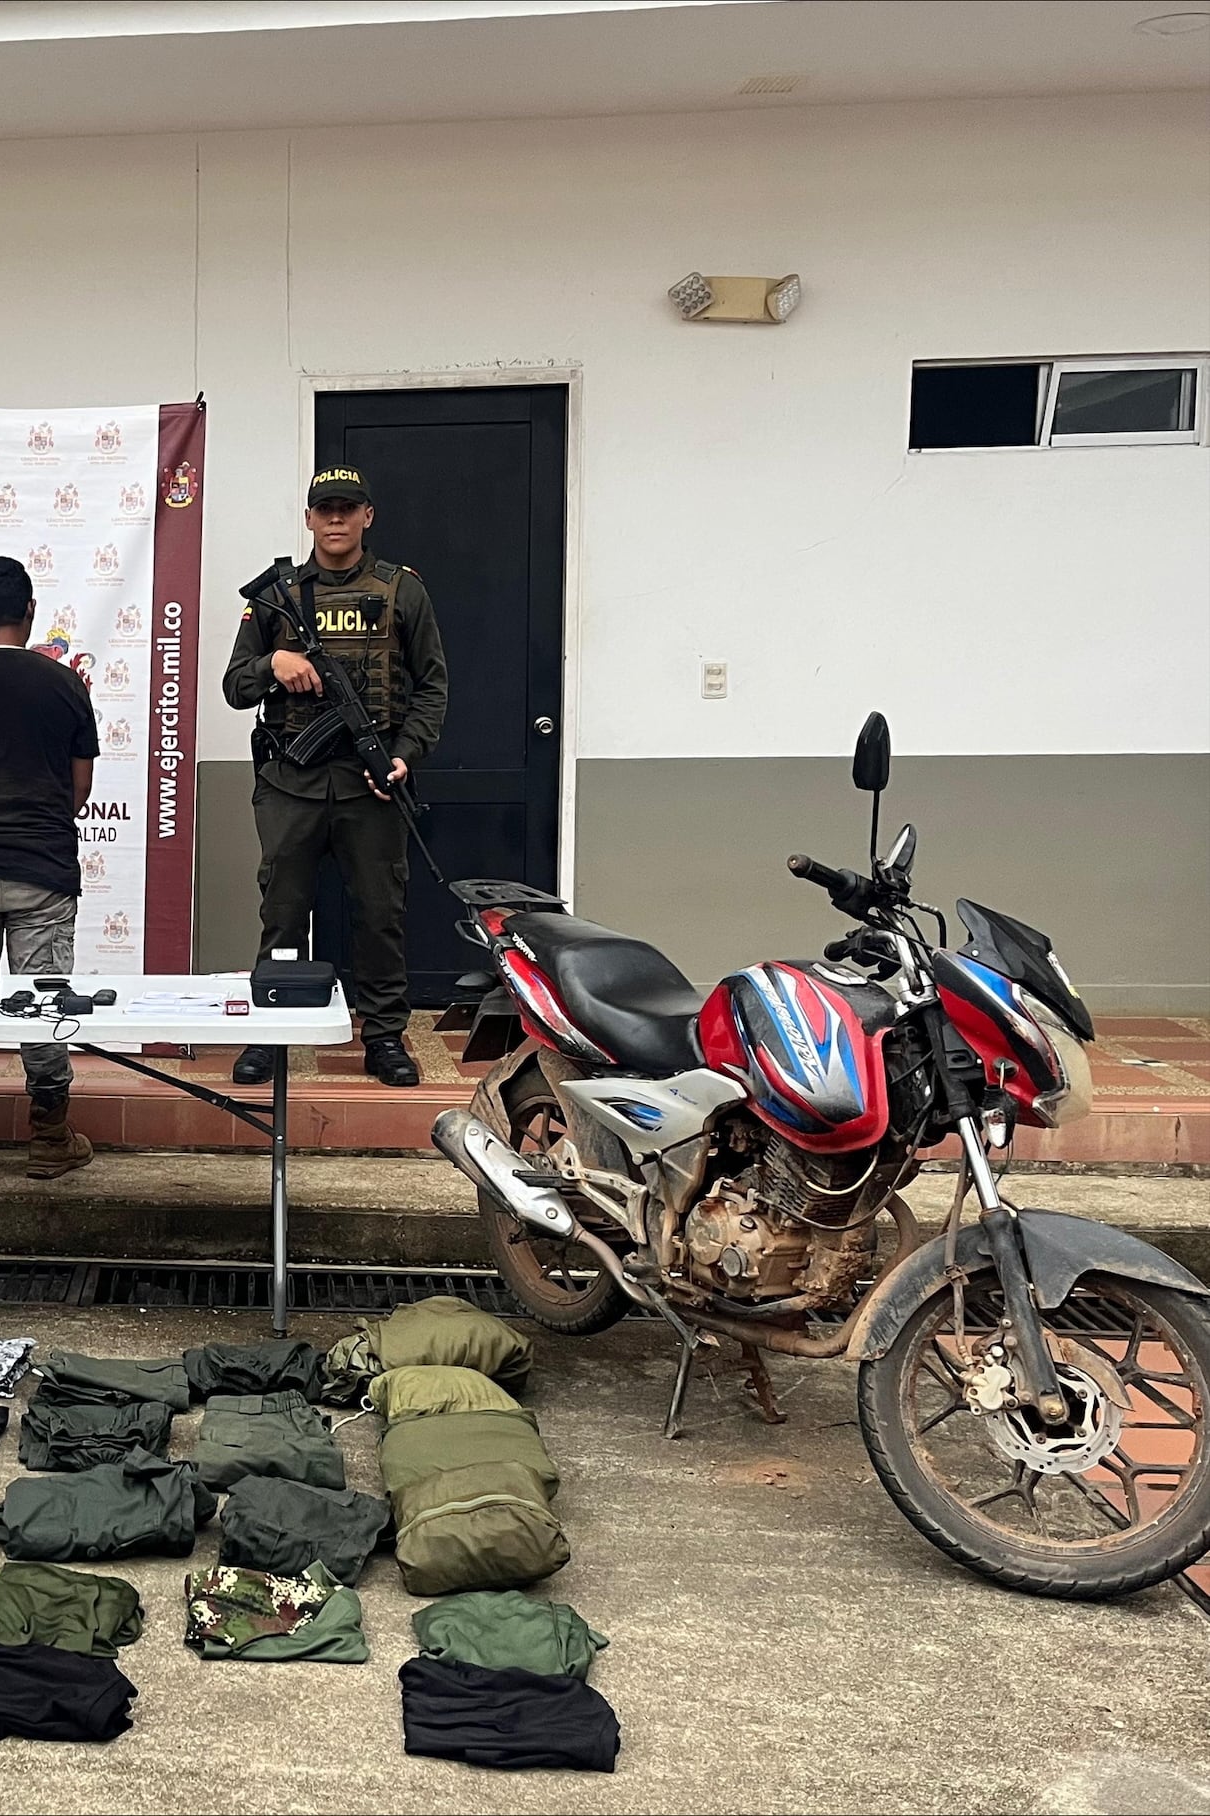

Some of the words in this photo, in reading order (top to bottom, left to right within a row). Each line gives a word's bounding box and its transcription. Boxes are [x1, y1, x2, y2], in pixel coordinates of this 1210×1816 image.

[313, 469, 360, 487] POLICIA
[315, 610, 378, 631] OLICI
[153, 601, 184, 838] www.ejercito.mil.co
[77, 802, 131, 820] ONAL
[77, 827, 117, 842] ALTAD
